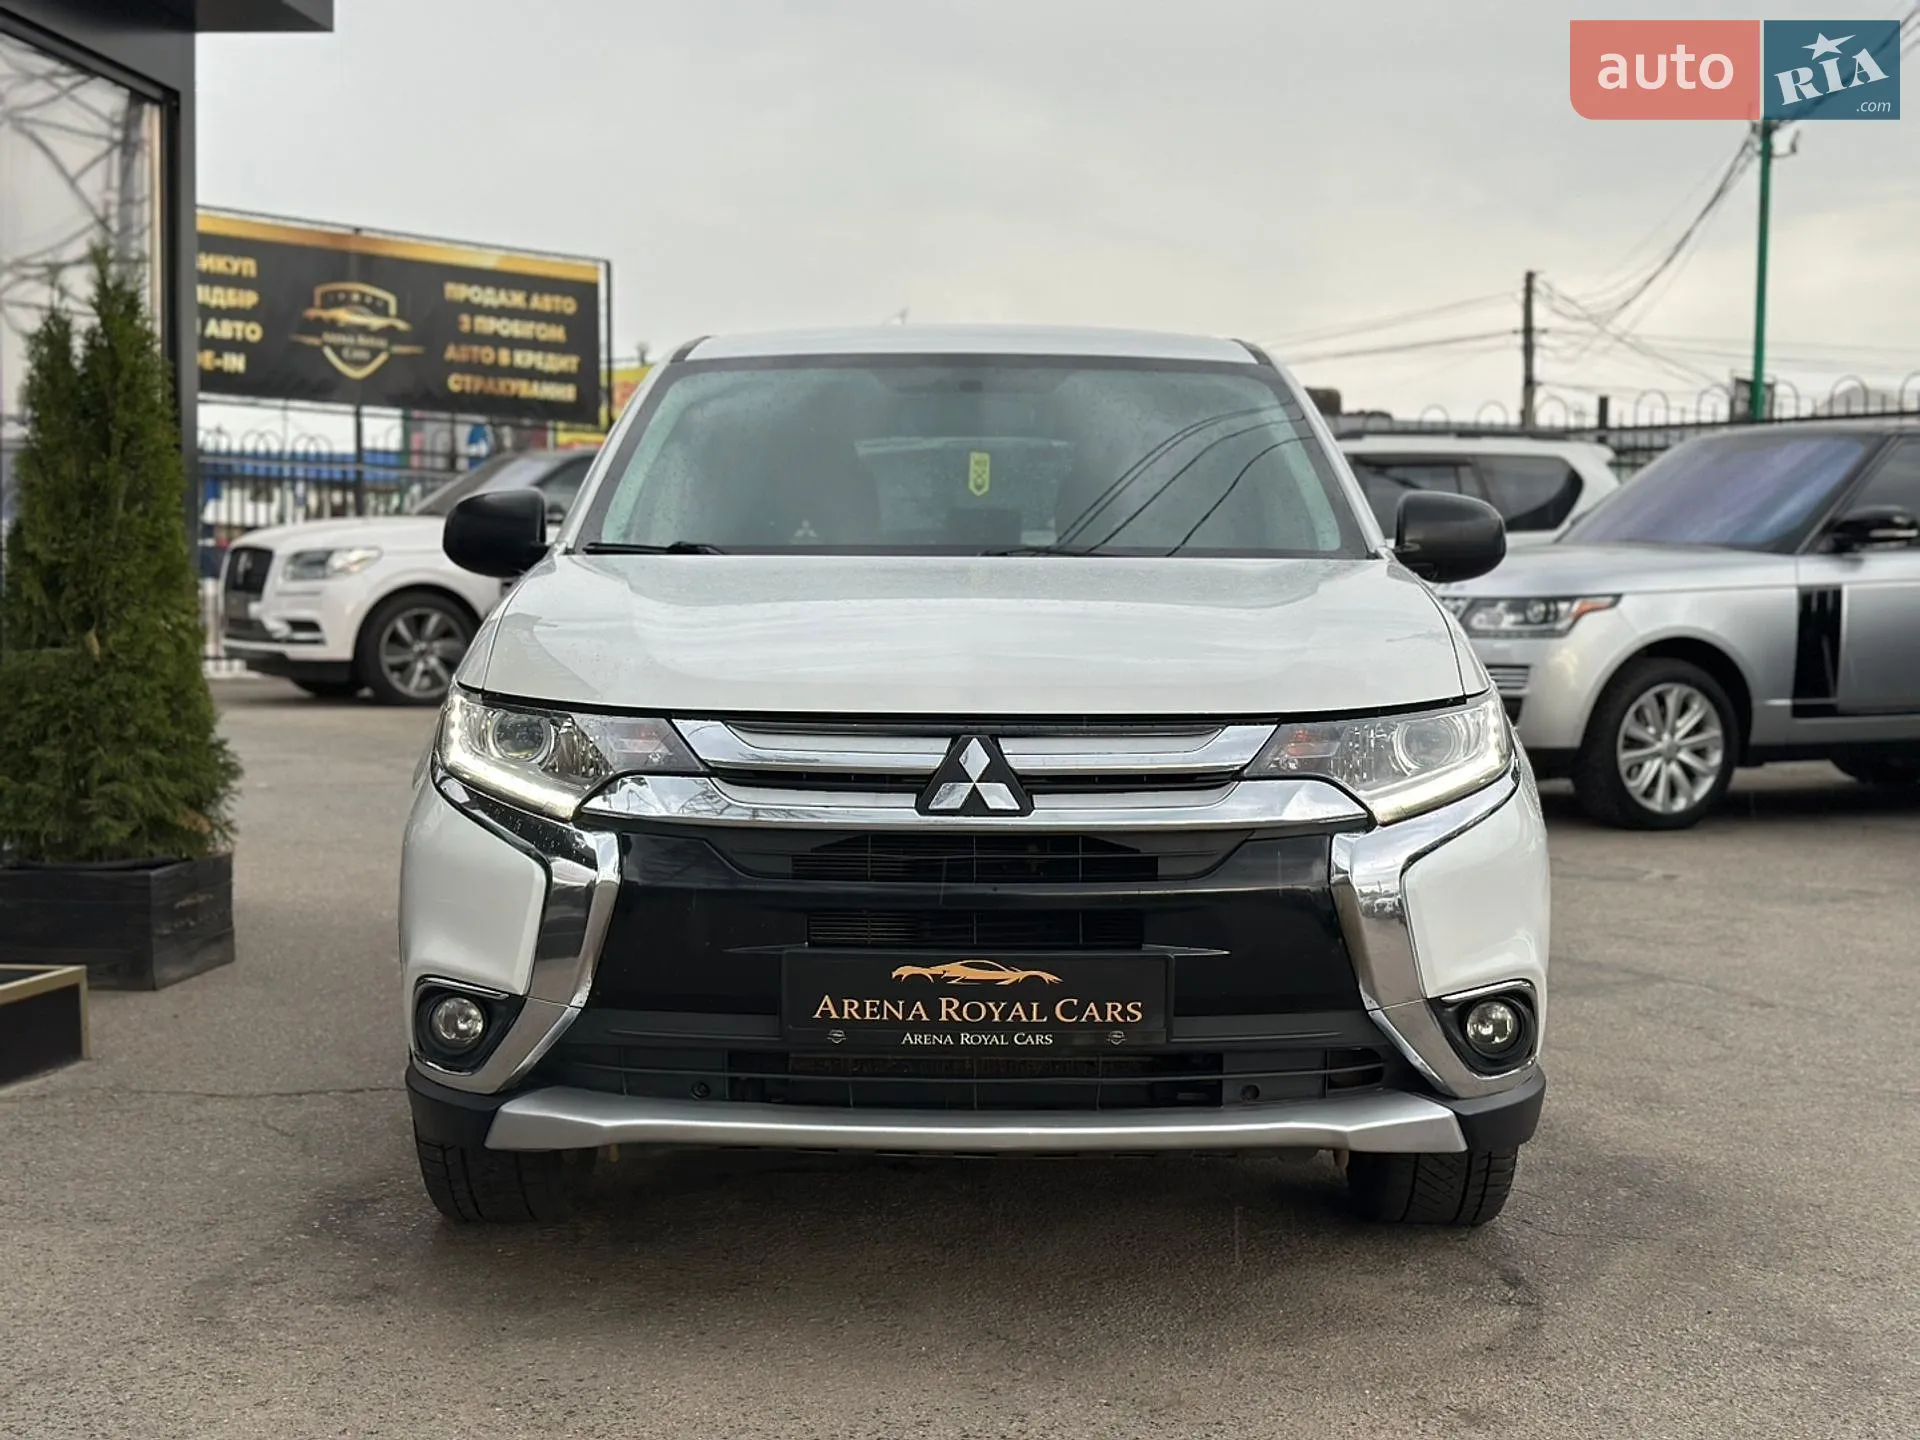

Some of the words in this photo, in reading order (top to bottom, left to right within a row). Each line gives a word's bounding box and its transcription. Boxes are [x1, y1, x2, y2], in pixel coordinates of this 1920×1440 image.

[444, 281, 528, 309] ПРОДАЖ
[529, 291, 578, 315] АВТО
[204, 317, 263, 343] АВТО
[473, 314, 567, 344] ПРОБІГОМ
[444, 341, 496, 366] АВТО
[497, 346, 511, 367] В
[512, 348, 580, 374] КРЕДИТ
[447, 372, 577, 403] СТРАХУВАННЯ
[812, 994, 930, 1020] ARENA
[938, 997, 1048, 1023] ROYAL
[1054, 998, 1143, 1023] CARS
[901, 1032, 954, 1045] ARENA
[960, 1032, 1009, 1045] ROYAL
[1013, 1032, 1053, 1045] CARS
